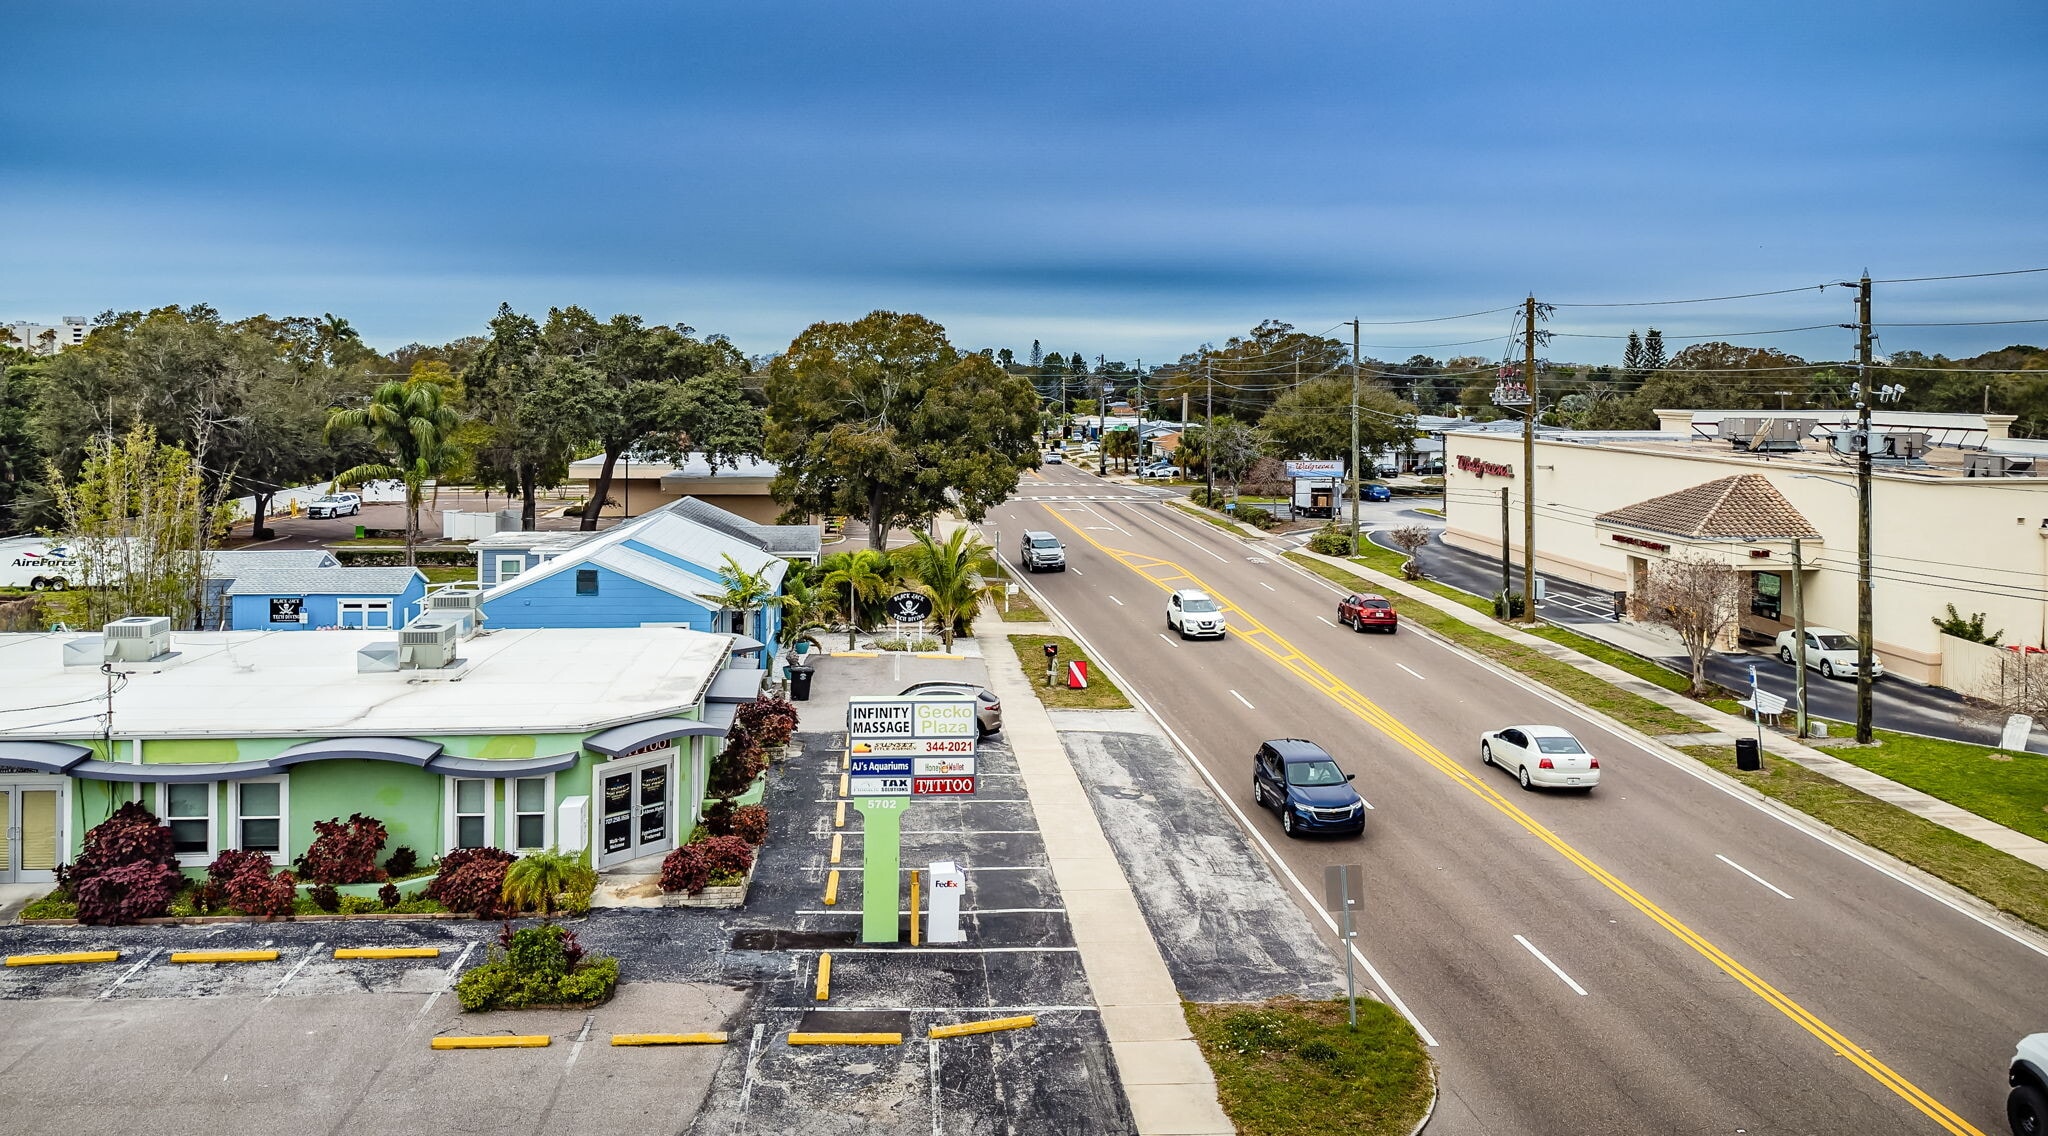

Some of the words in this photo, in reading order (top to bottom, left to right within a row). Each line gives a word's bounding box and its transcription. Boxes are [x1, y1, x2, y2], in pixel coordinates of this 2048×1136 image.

[1295, 462, 1335, 472] Walgreens
[1456, 455, 1515, 479] Walgreens
[11, 558, 77, 567] AireForce
[894, 593, 910, 602] BLACK
[911, 594, 925, 602] JACK
[893, 613, 907, 621] TECH
[853, 707, 909, 719] INFINITY
[917, 705, 972, 719] Gecko
[853, 721, 910, 734] MASSAGE
[921, 721, 968, 733] Plaza
[926, 741, 973, 752] 344-2021
[852, 761, 868, 771] AJ's
[868, 761, 909, 773] Aquariums
[881, 779, 908, 787] TAX
[916, 779, 973, 794] TATTOO
[867, 799, 897, 809] 5702
[935, 880, 958, 888] FedEx
